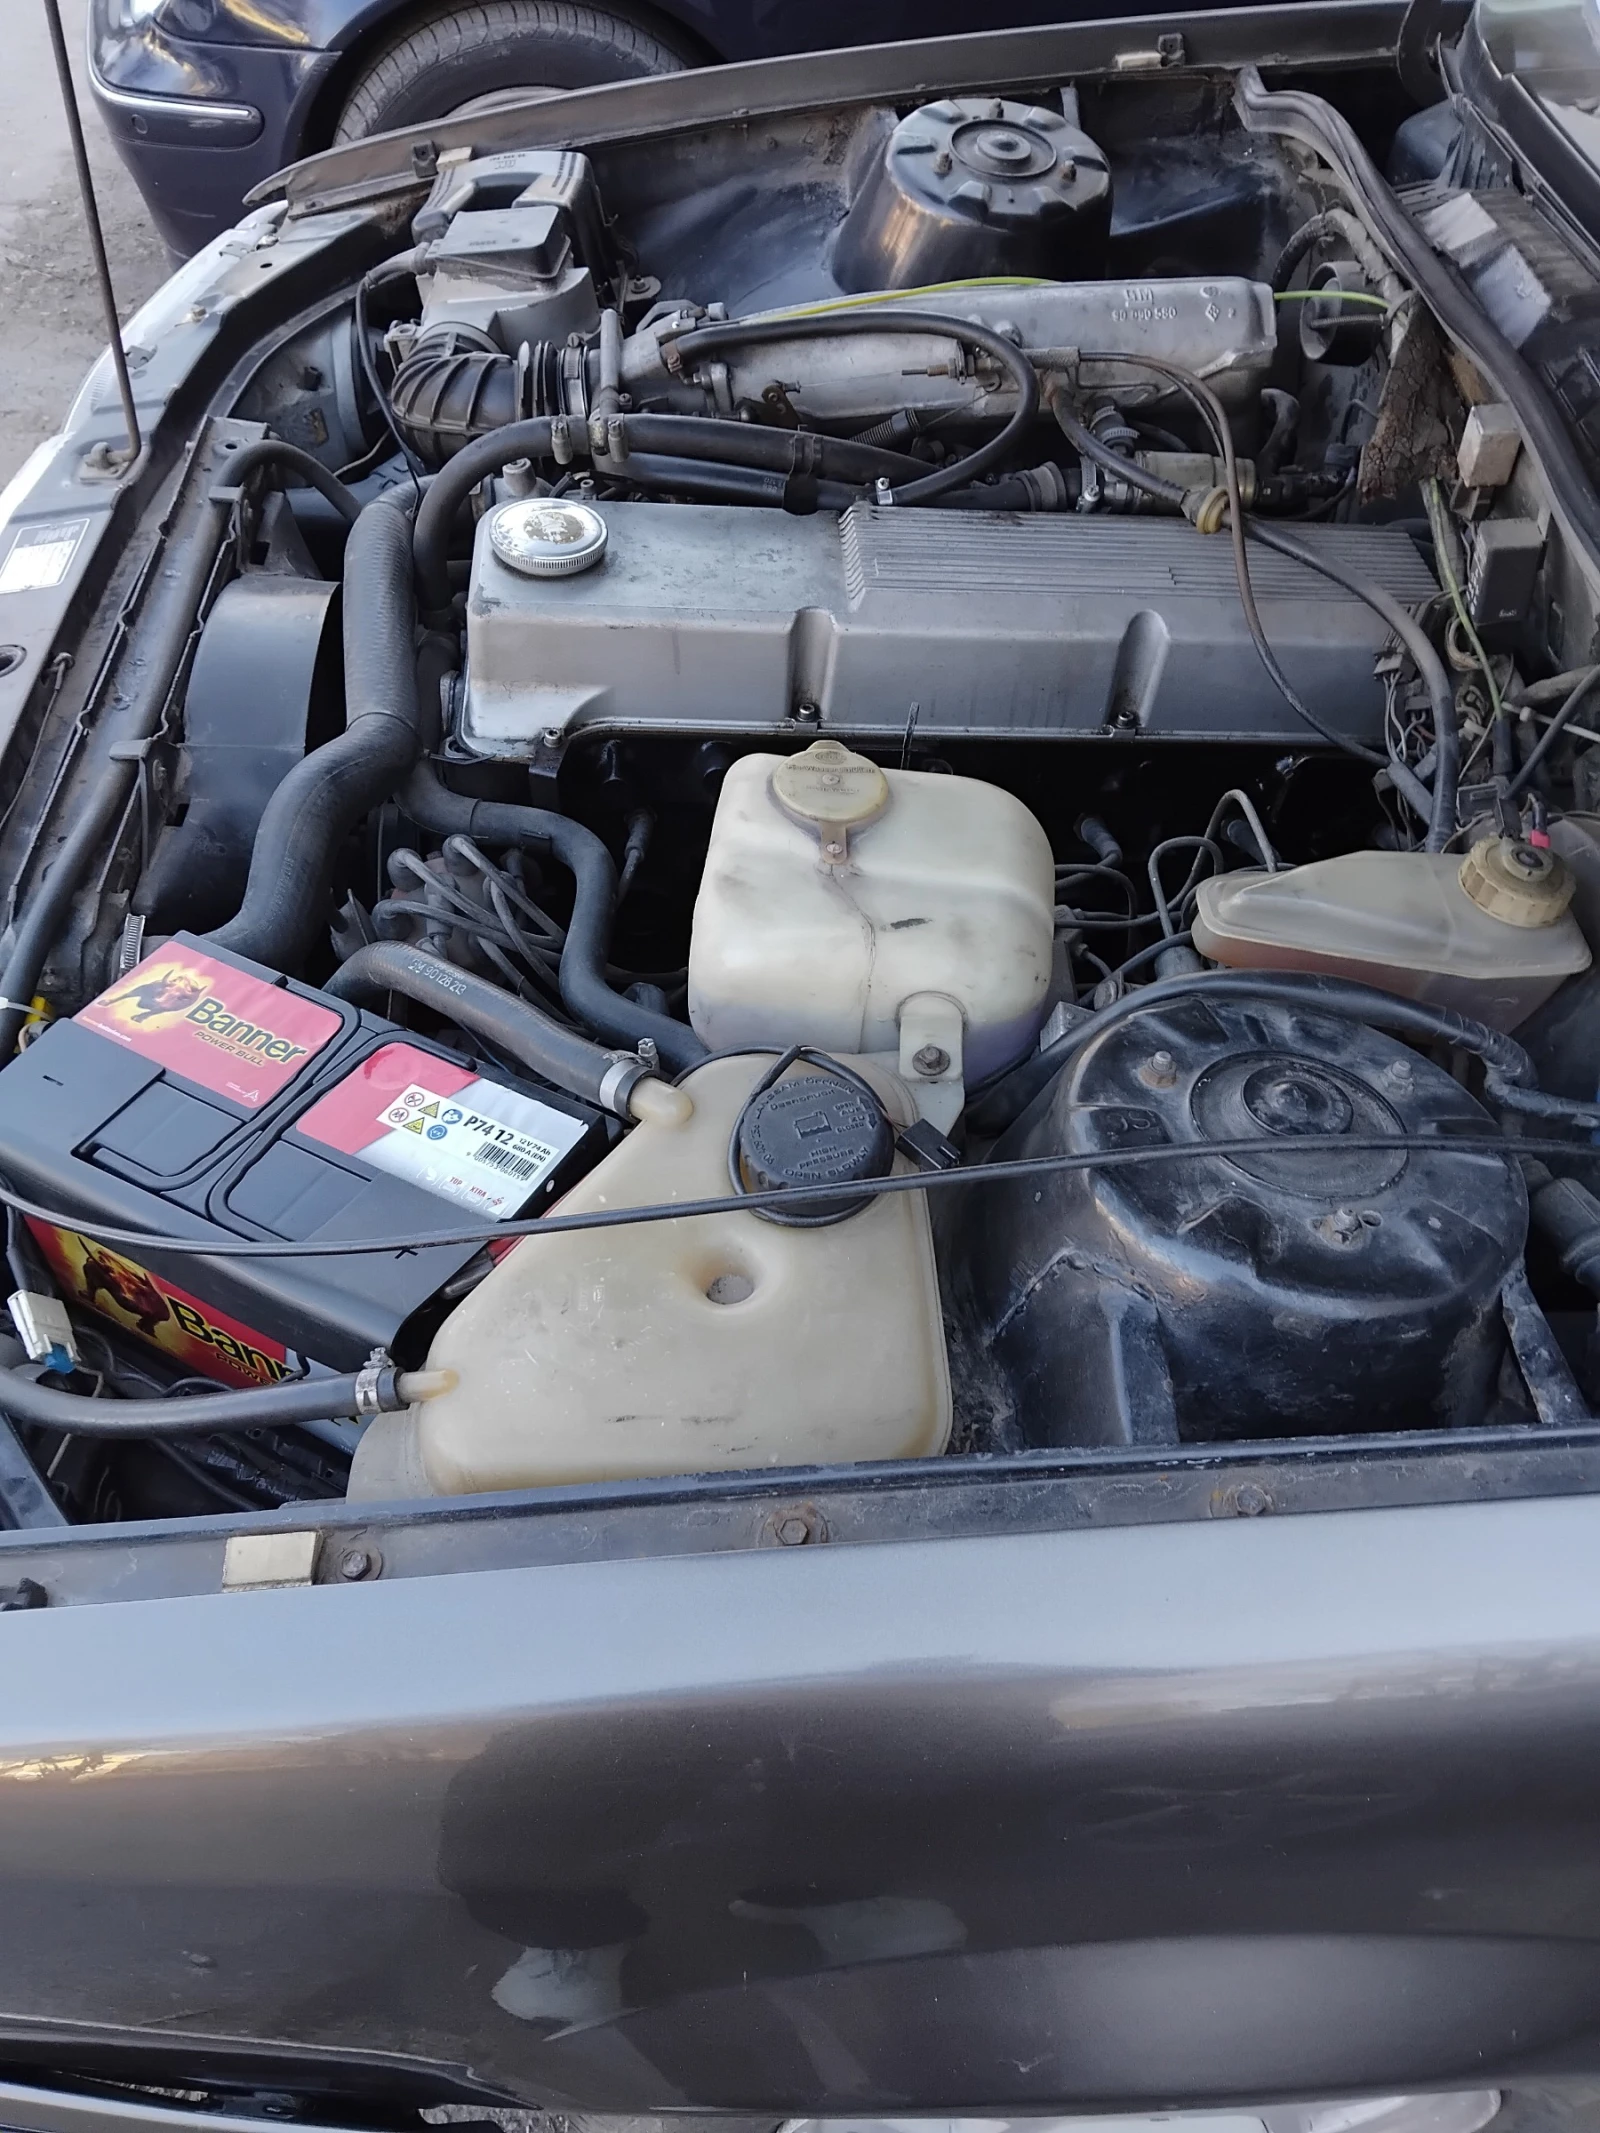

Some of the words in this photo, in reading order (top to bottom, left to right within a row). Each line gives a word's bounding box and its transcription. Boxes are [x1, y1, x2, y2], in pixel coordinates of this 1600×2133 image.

[424, 966, 439, 979] 90
[185, 997, 307, 1064] Banner
[194, 1030, 234, 1052] POWER
[234, 1049, 264, 1066] BULL
[463, 1115, 495, 1136] P74
[494, 1129, 515, 1146] 12
[799, 1148, 855, 1170] PRESSURE
[810, 1145, 838, 1158] HIGH
[784, 1168, 823, 1180] OPEN
[826, 1146, 869, 1177] SLOWLY
[449, 1176, 463, 1186] TOP
[469, 1186, 487, 1198] XTRA
